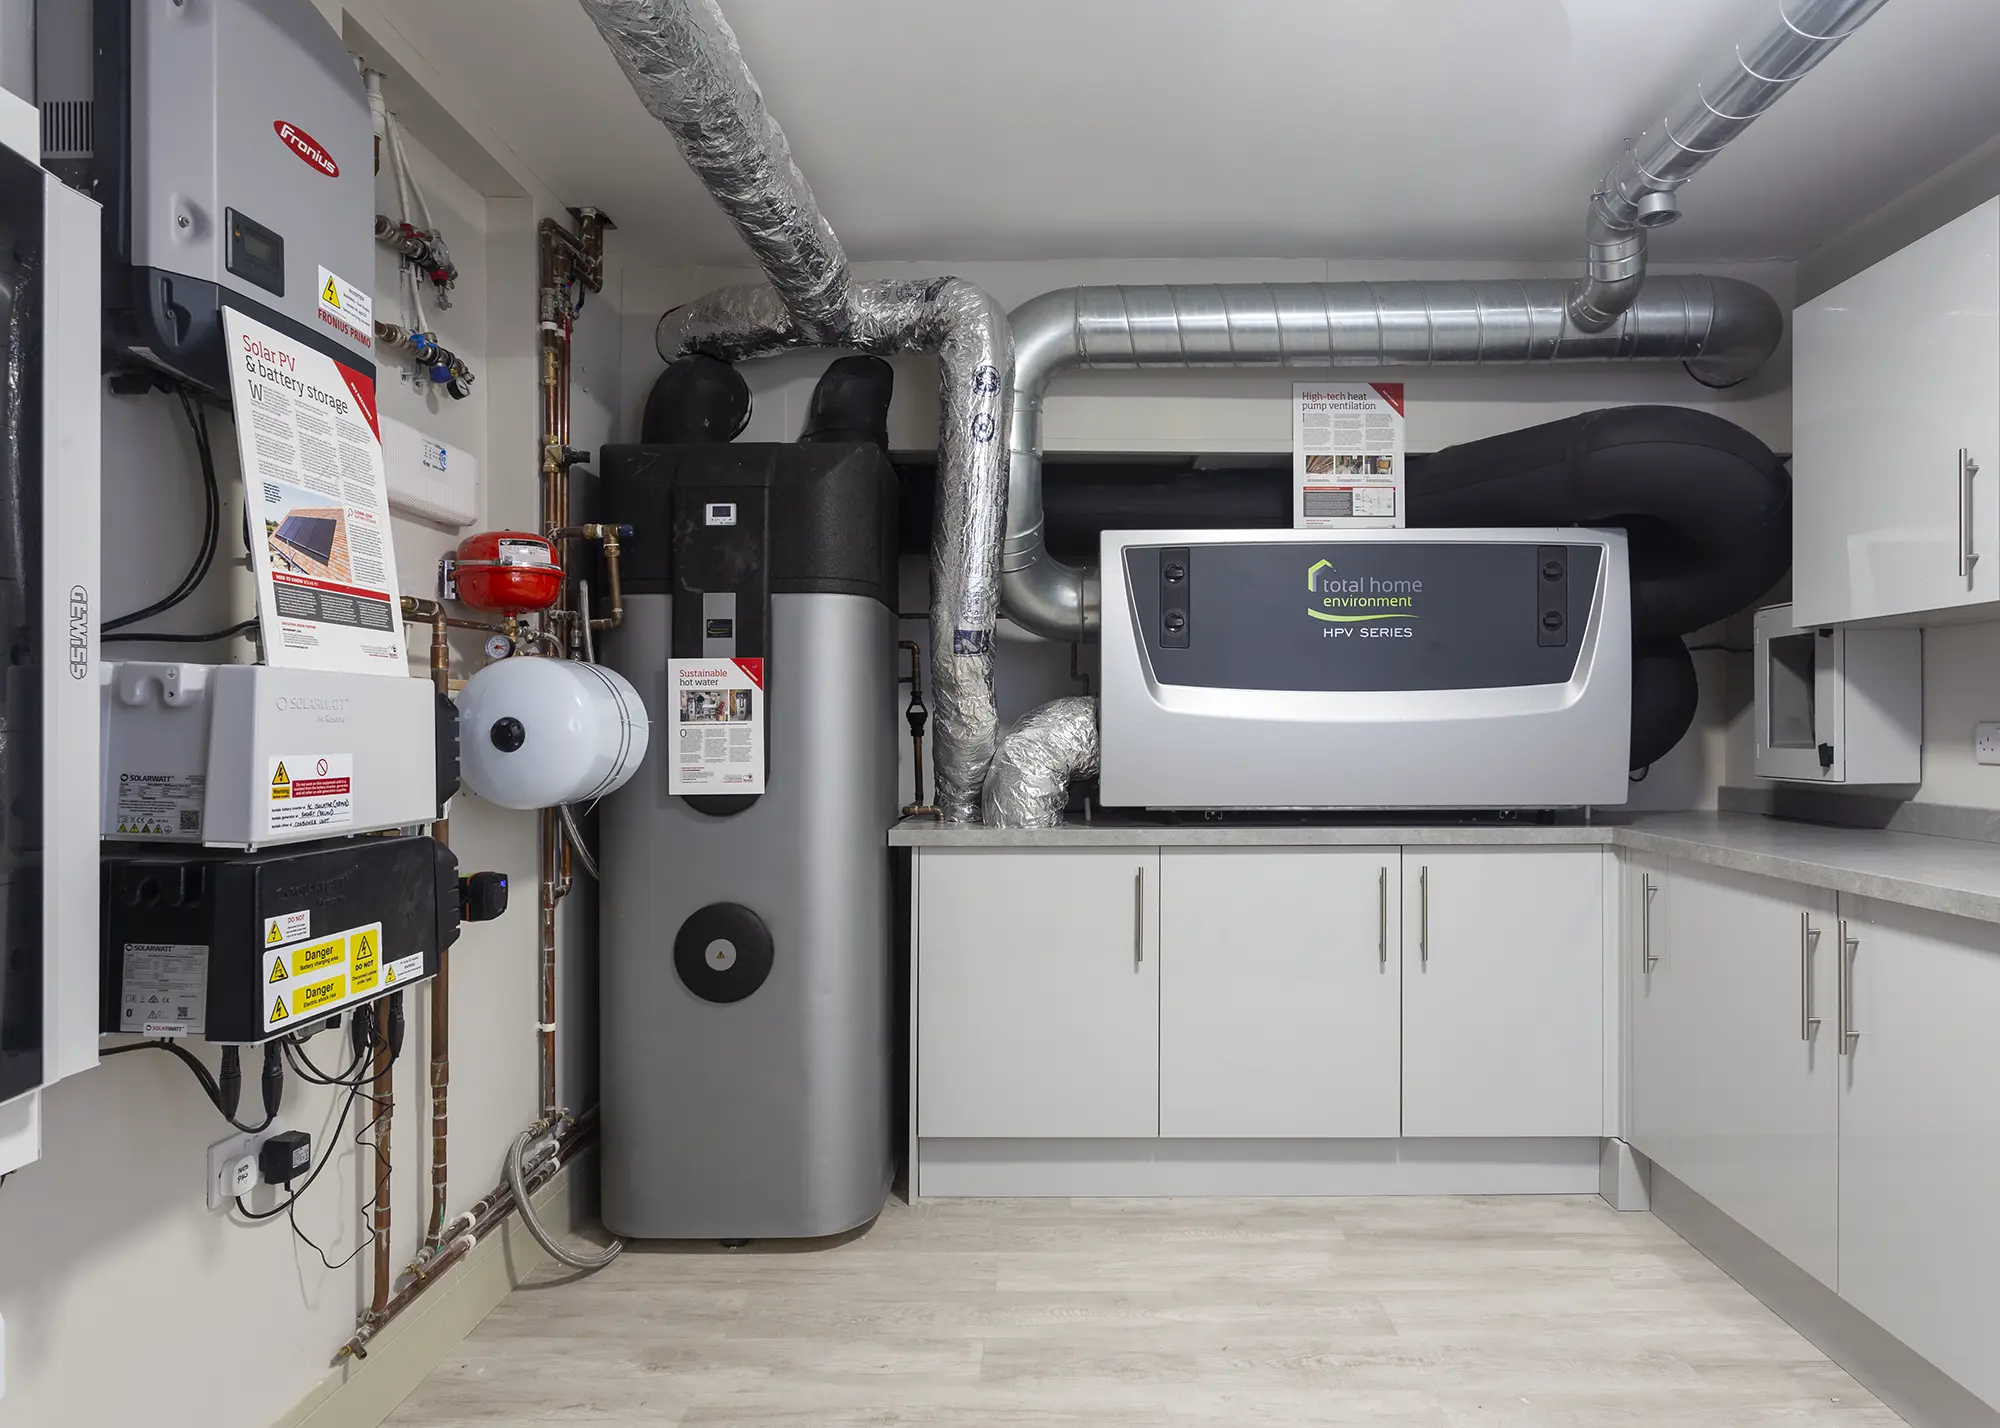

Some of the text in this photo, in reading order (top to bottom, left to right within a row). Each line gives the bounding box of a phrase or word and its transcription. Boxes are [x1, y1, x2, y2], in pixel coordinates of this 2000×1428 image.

[280, 124, 336, 174] Fronius
[318, 308, 349, 335] FRONIUS
[350, 328, 371, 348] PRIMO
[242, 334, 296, 372] Solar PV
[246, 355, 349, 415] & battery storage
[248, 379, 263, 402] W
[1302, 392, 1367, 403] High-tech heat
[1302, 401, 1376, 412] pump ventilation
[1323, 577, 1423, 593] total home
[1323, 594, 1412, 607] environment
[1323, 627, 1413, 638] HPV SERIES
[679, 669, 728, 678] Sustainable
[679, 678, 719, 687] hot water
[130, 774, 172, 783] SOLARWATT
[287, 914, 305, 924] DO NOT
[305, 945, 334, 962] Danger
[300, 962, 314, 971] Battery
[314, 958, 331, 968] charging
[355, 960, 374, 971] DO NOT
[305, 983, 335, 999] Danger
[303, 992, 337, 1009] Electric shock risk
